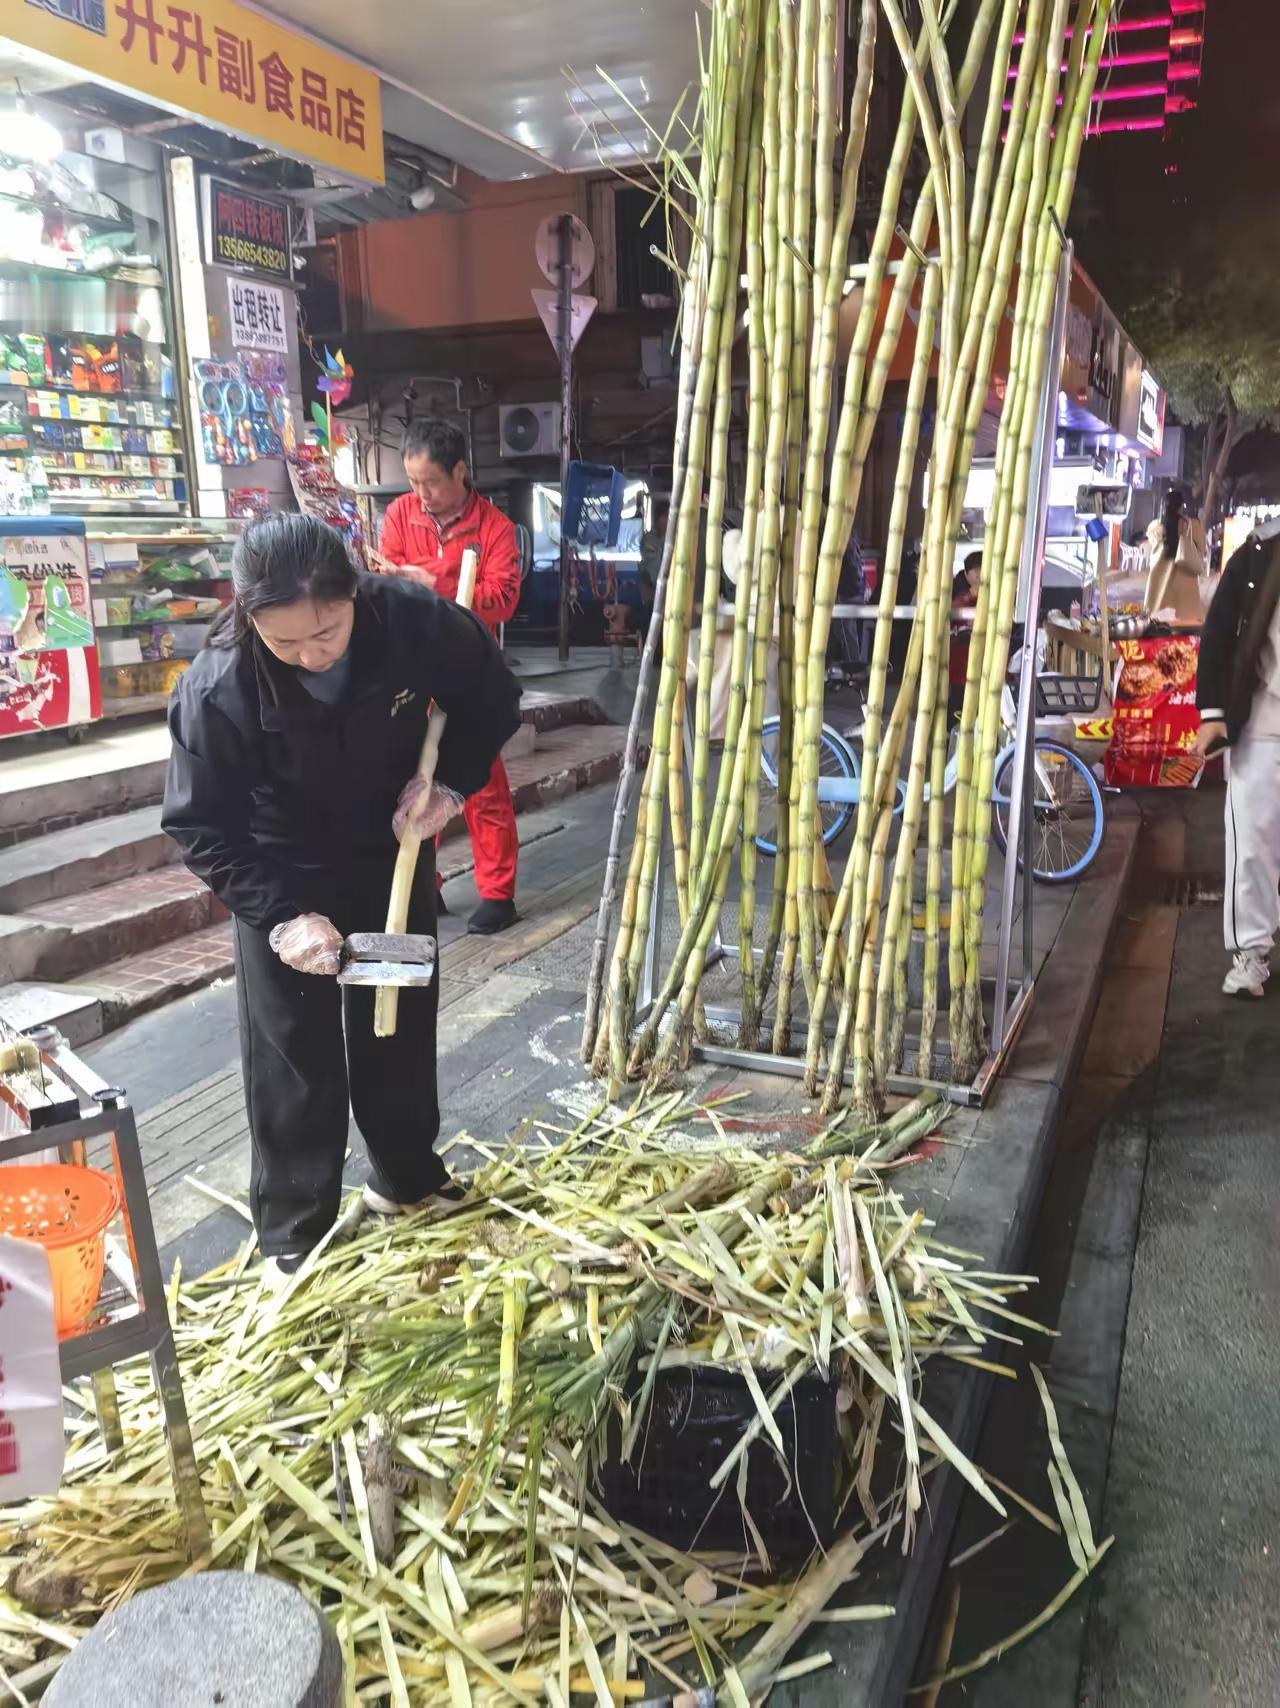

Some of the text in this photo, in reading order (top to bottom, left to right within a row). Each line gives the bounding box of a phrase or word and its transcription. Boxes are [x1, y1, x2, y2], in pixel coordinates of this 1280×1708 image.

[217, 235, 287, 271] 13566543820
[232, 284, 283, 332] 出租转让
